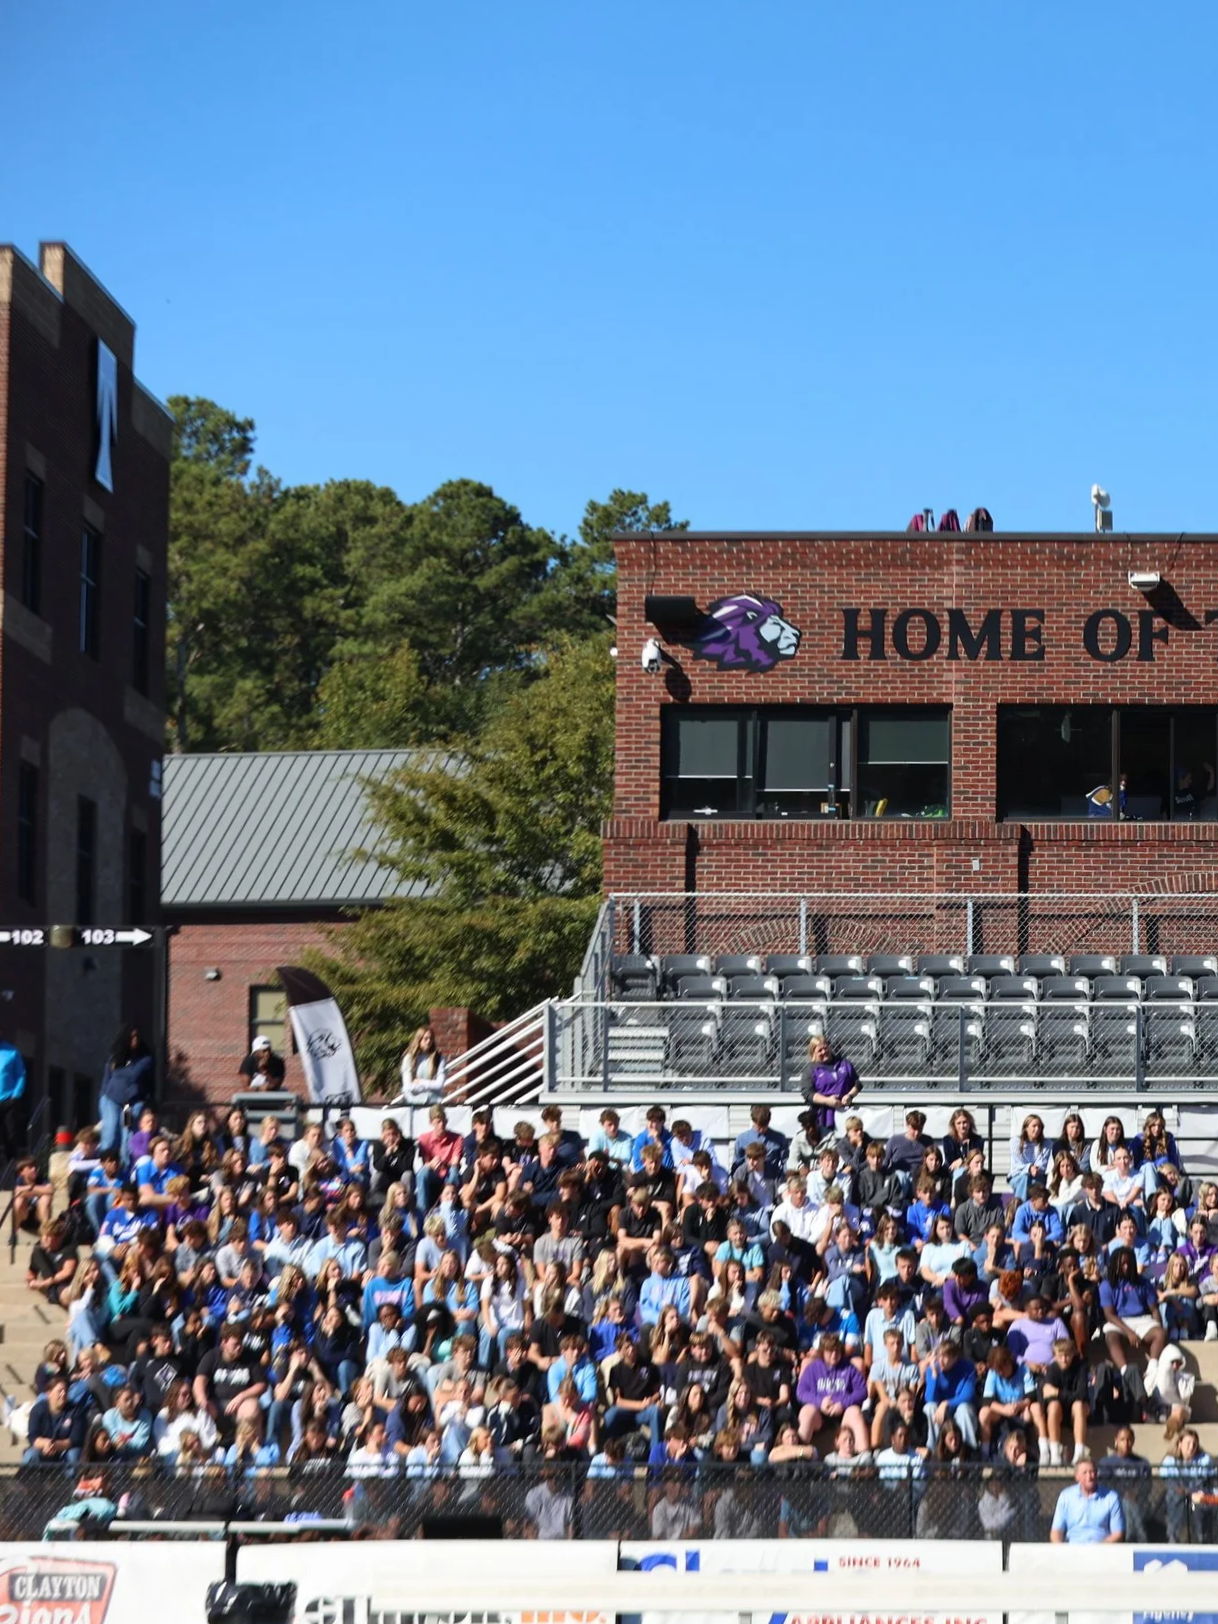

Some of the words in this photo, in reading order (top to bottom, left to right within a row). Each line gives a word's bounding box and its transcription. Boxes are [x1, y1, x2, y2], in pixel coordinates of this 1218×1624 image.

[841, 607, 1046, 662] HOME
[1083, 608, 1169, 662] OF
[10, 929, 44, 945] 102
[82, 929, 115, 945] 103
[838, 1556, 881, 1569] SINCE
[887, 1556, 921, 1569] 1964
[14, 1574, 102, 1600] CLAYTON
